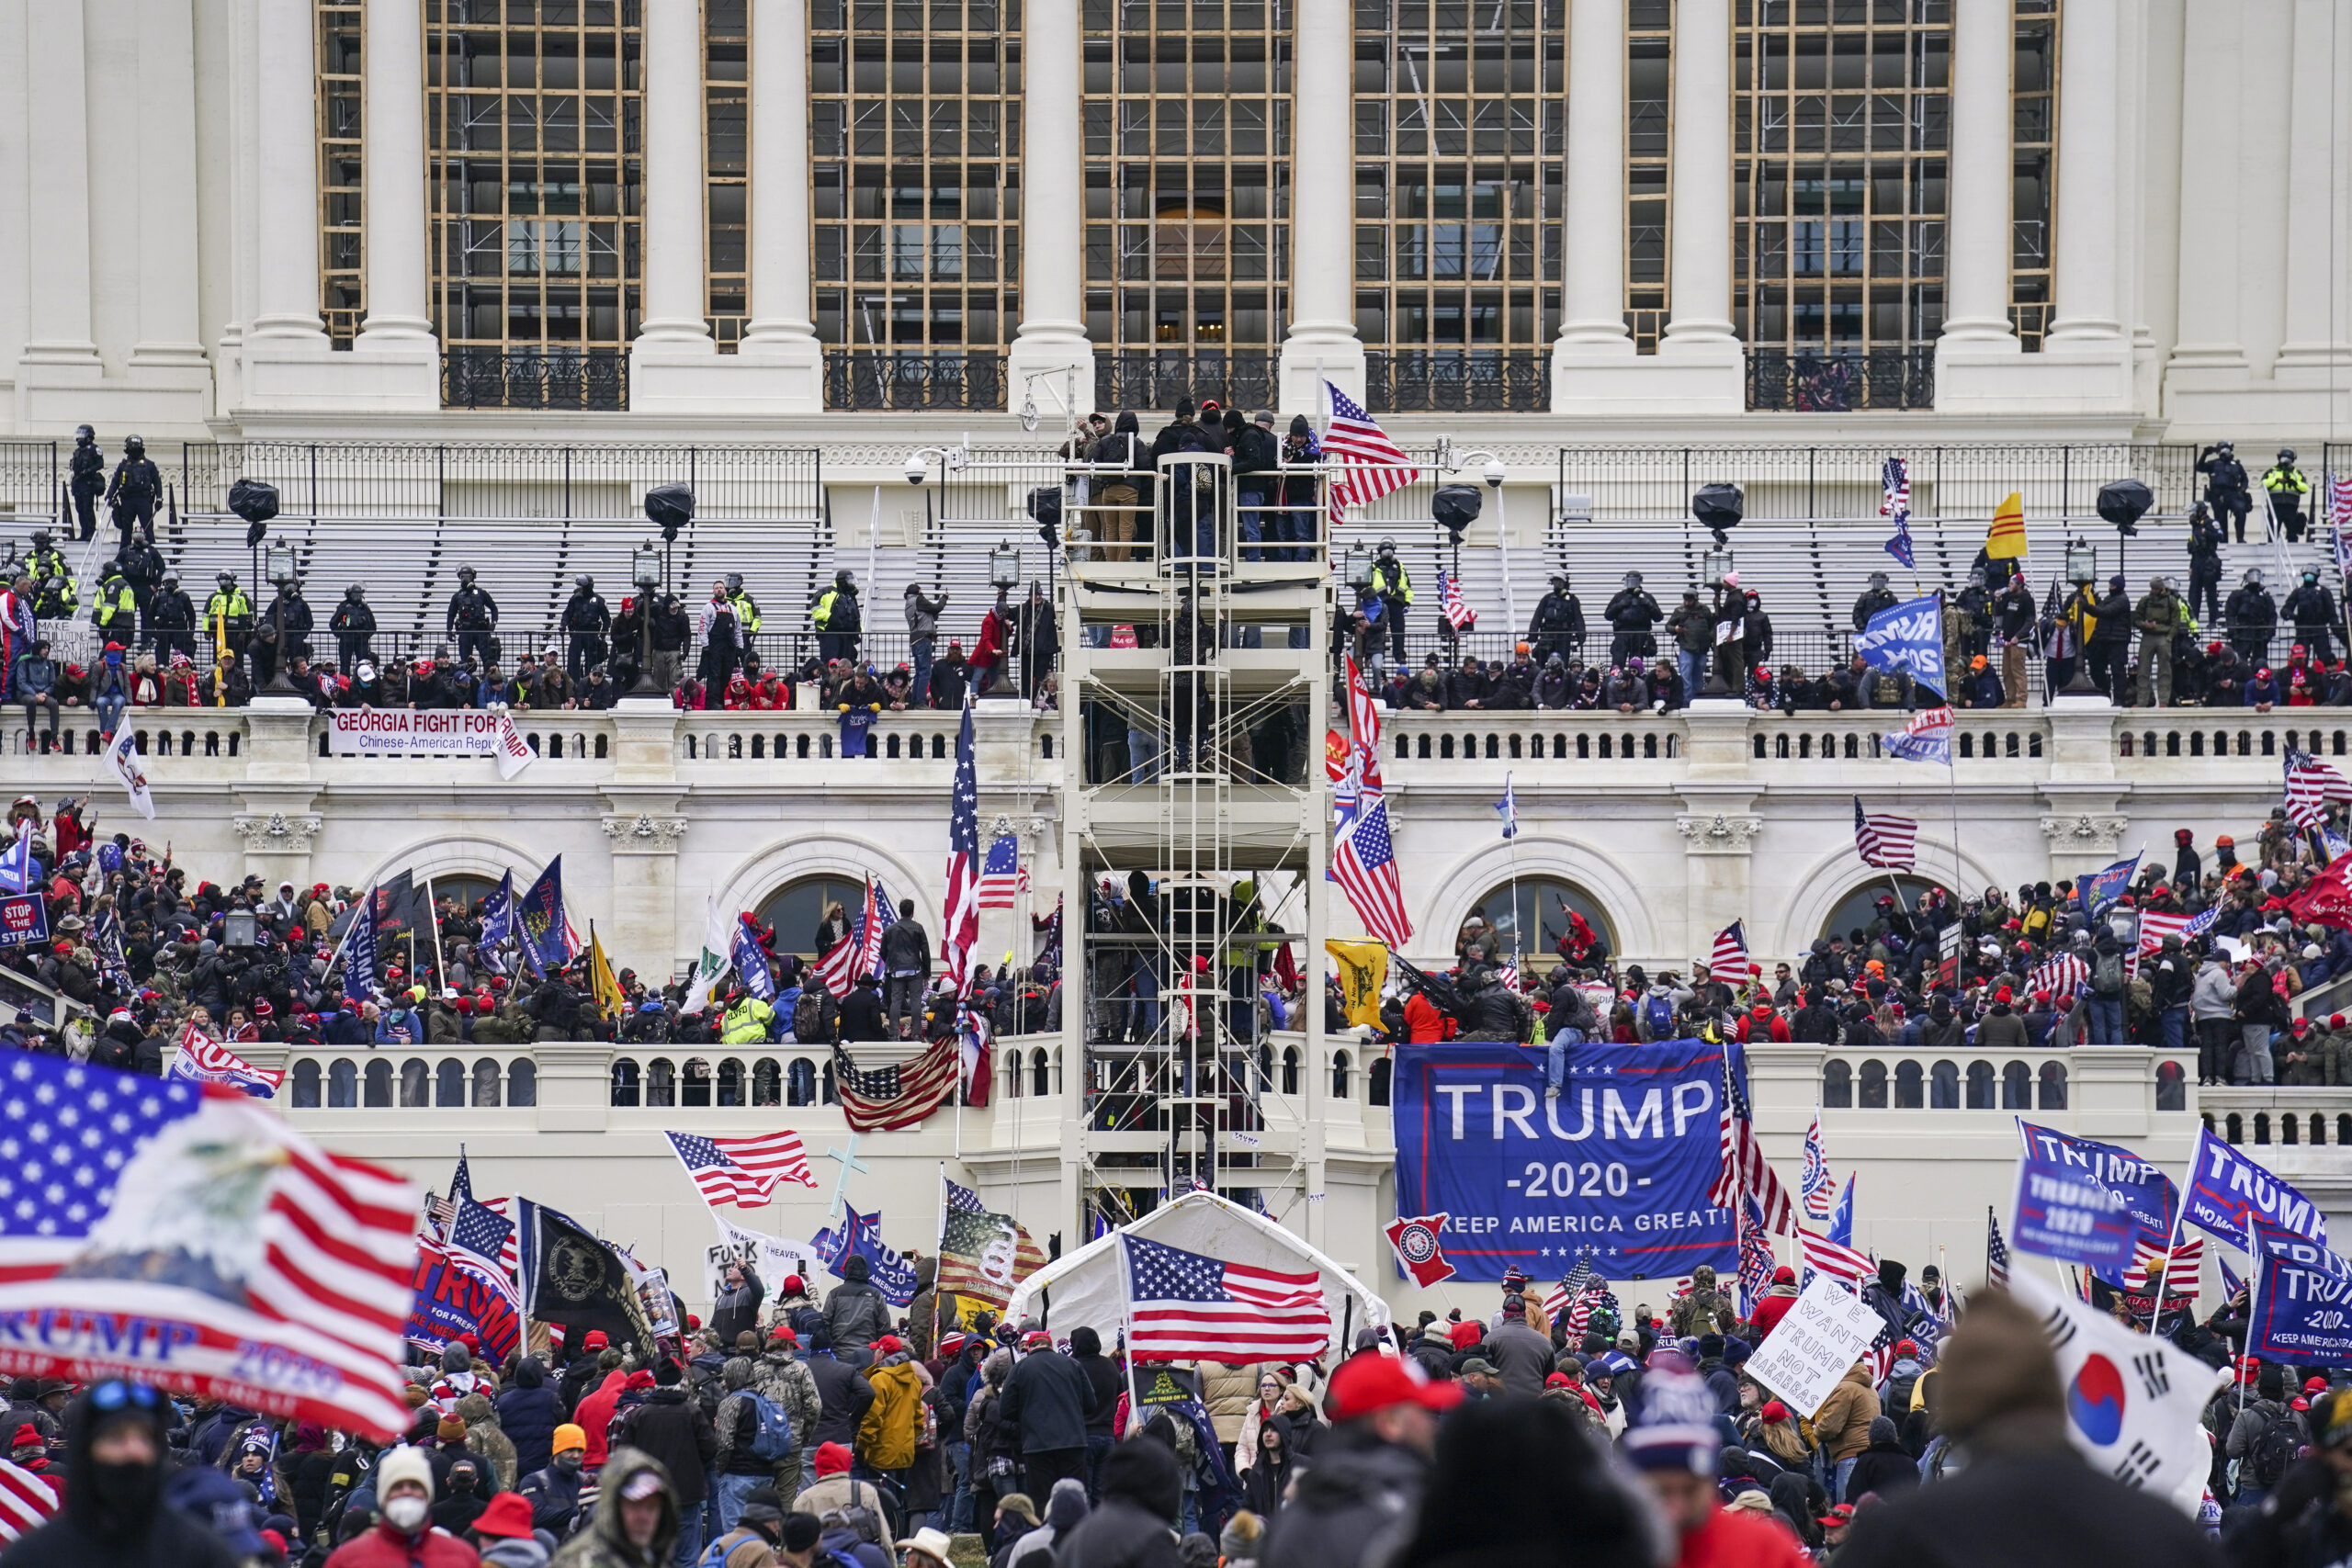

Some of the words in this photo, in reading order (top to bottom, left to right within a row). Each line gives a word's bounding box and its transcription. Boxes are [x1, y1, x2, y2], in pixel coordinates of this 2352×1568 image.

[38, 622, 70, 631] MAKE
[51, 641, 75, 653] REAT
[337, 713, 409, 731] GEORGIA
[413, 715, 460, 732] FIGHT
[465, 715, 497, 733] FOR
[501, 716, 528, 758] RUMP
[359, 735, 462, 750] Chinese-American
[5, 904, 32, 919] STOP
[10, 919, 30, 928] THE
[2, 928, 44, 943] STEAL
[514, 909, 530, 943] AMERICA
[527, 942, 544, 966] GREAT
[1600, 996, 1614, 1004] DIA
[183, 1061, 194, 1073] NO
[1435, 1079, 1714, 1141] TRUMP
[1234, 1132, 1258, 1144] TRUMP
[1507, 1161, 1652, 1197] -2020-
[2209, 1143, 2327, 1241] TRUMP
[1440, 1216, 1500, 1234] KEEP
[1510, 1215, 1623, 1233] AMERICA
[1634, 1208, 1727, 1232] GREAT!
[2045, 1205, 2095, 1236] 2020
[2131, 1210, 2164, 1229] GREAT!
[2194, 1201, 2215, 1224] NO
[709, 1240, 759, 1263] FUCK
[770, 1247, 801, 1260] HEAVEN
[869, 1274, 900, 1297] AMERICA
[431, 1306, 449, 1320] FOR
[1825, 1283, 1866, 1324] WE
[1800, 1300, 1868, 1354] WANT
[1779, 1317, 1846, 1372] TRUMP
[2271, 1333, 2299, 1344] KEEP
[2301, 1335, 2341, 1348] AMERICA
[0, 1309, 200, 1361] RUMP
[232, 1338, 345, 1398] 2020
[0, 1348, 55, 1374] EEP
[1776, 1348, 1821, 1384] NOT
[1749, 1351, 1819, 1408] BARABBAS
